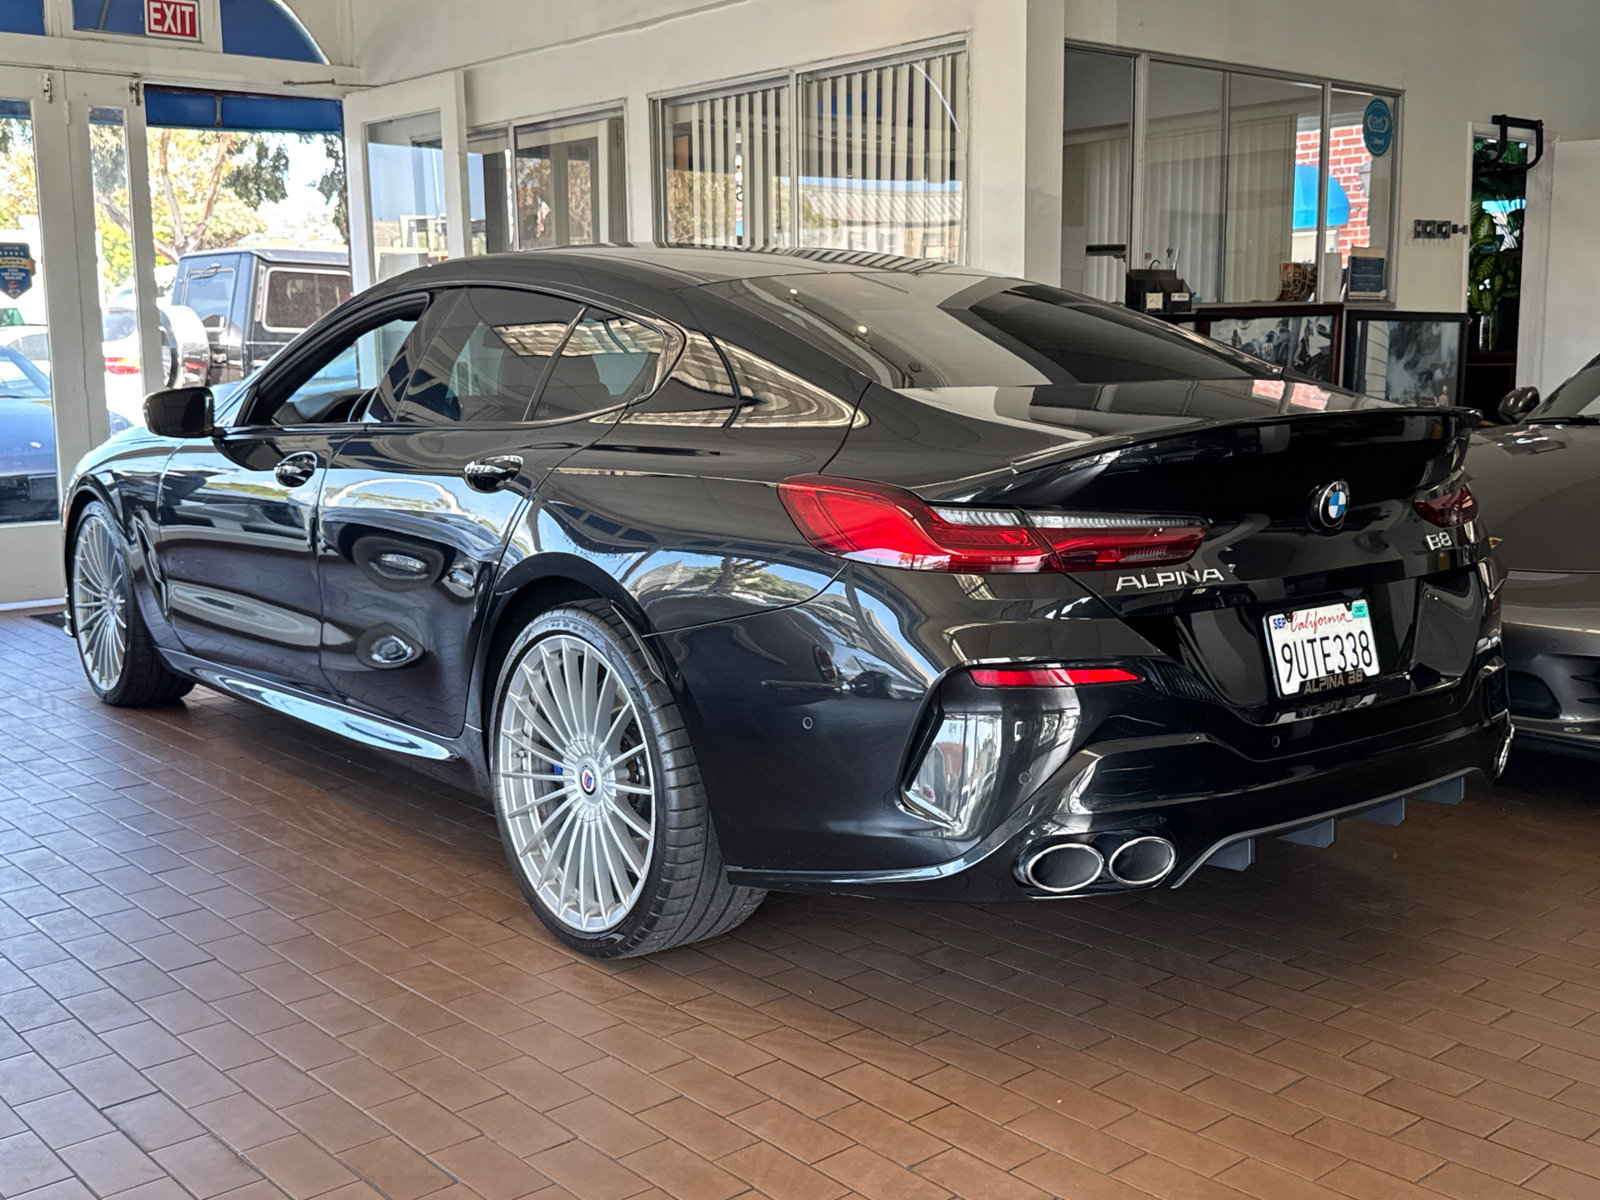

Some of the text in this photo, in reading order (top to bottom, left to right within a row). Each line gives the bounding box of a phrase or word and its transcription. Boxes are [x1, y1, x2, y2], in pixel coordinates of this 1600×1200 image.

[150, 1, 194, 35] EXIT
[1426, 532, 1453, 550] B8
[1115, 568, 1225, 592] ALPINA
[1272, 617, 1287, 630] SEP
[1289, 609, 1354, 635] California
[1281, 630, 1373, 683] 9UTE338
[1303, 671, 1345, 694] ALPINA
